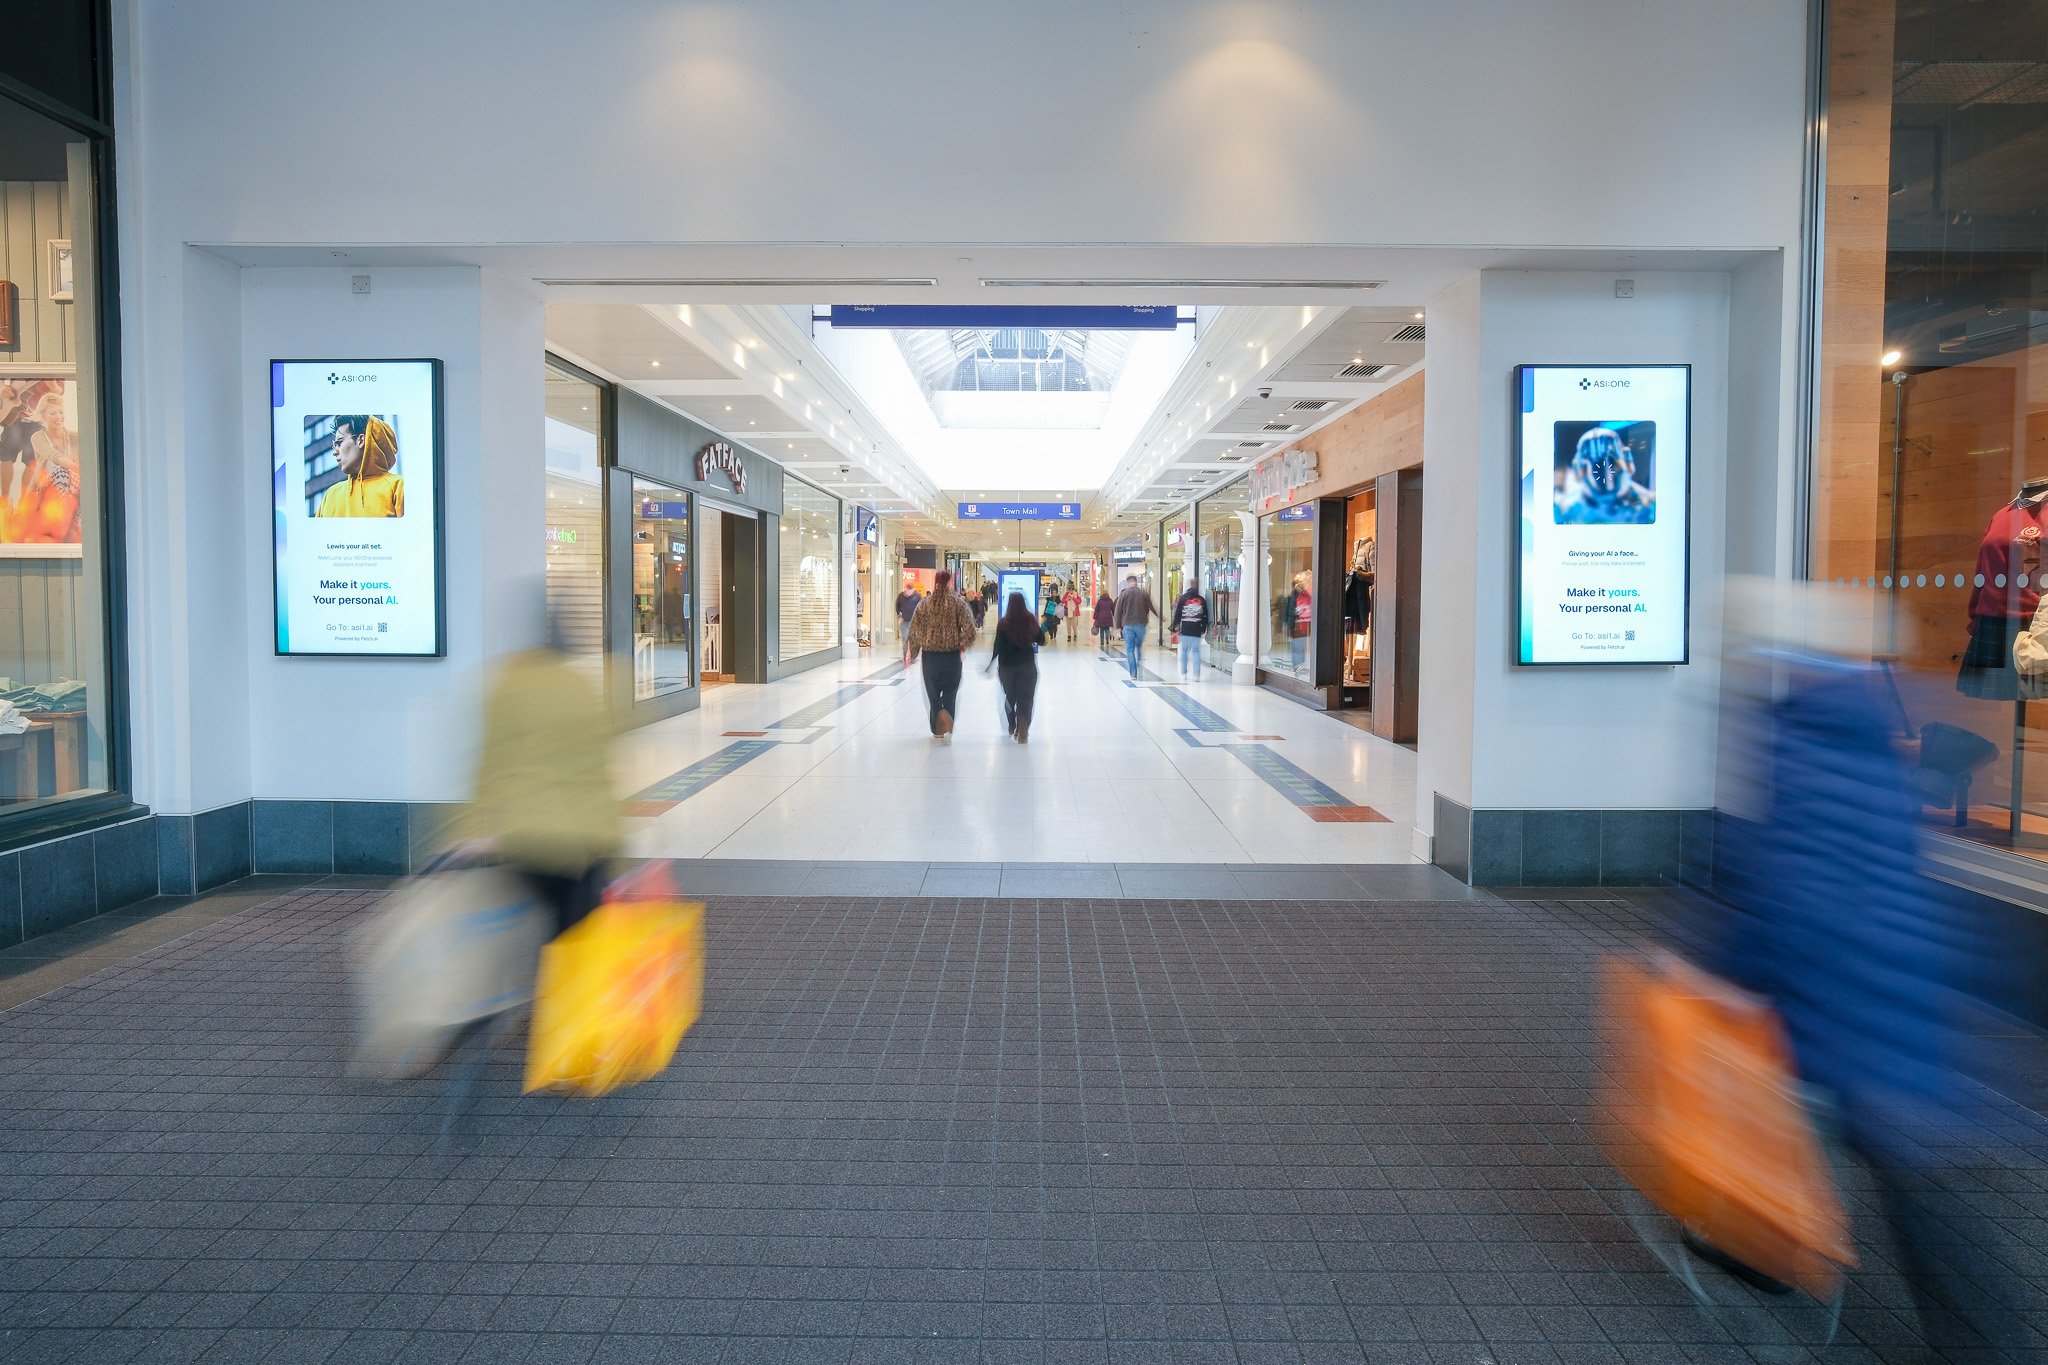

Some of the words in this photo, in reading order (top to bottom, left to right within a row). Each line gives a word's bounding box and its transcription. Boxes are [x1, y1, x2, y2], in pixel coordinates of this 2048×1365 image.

[698, 442, 748, 495] FATFACE
[1002, 507, 1020, 515] Town
[1022, 507, 1038, 515] Mall
[1568, 550, 1590, 558] Giving
[320, 580, 348, 589] Make
[350, 579, 358, 589] it
[360, 581, 391, 591] yours.
[1567, 587, 1596, 597] Make
[1598, 587, 1605, 597] it
[1608, 588, 1640, 599] yours.
[313, 595, 336, 605] Your
[338, 595, 384, 606] personal
[385, 596, 399, 605] AI.
[1559, 603, 1583, 613] Your
[1585, 603, 1632, 615] personal
[1634, 604, 1647, 613] AI.
[326, 624, 337, 632] Go
[338, 624, 349, 632] To:
[1571, 632, 1583, 640] Go
[1585, 632, 1596, 640] To:
[1597, 632, 1620, 640] asi1.ai
